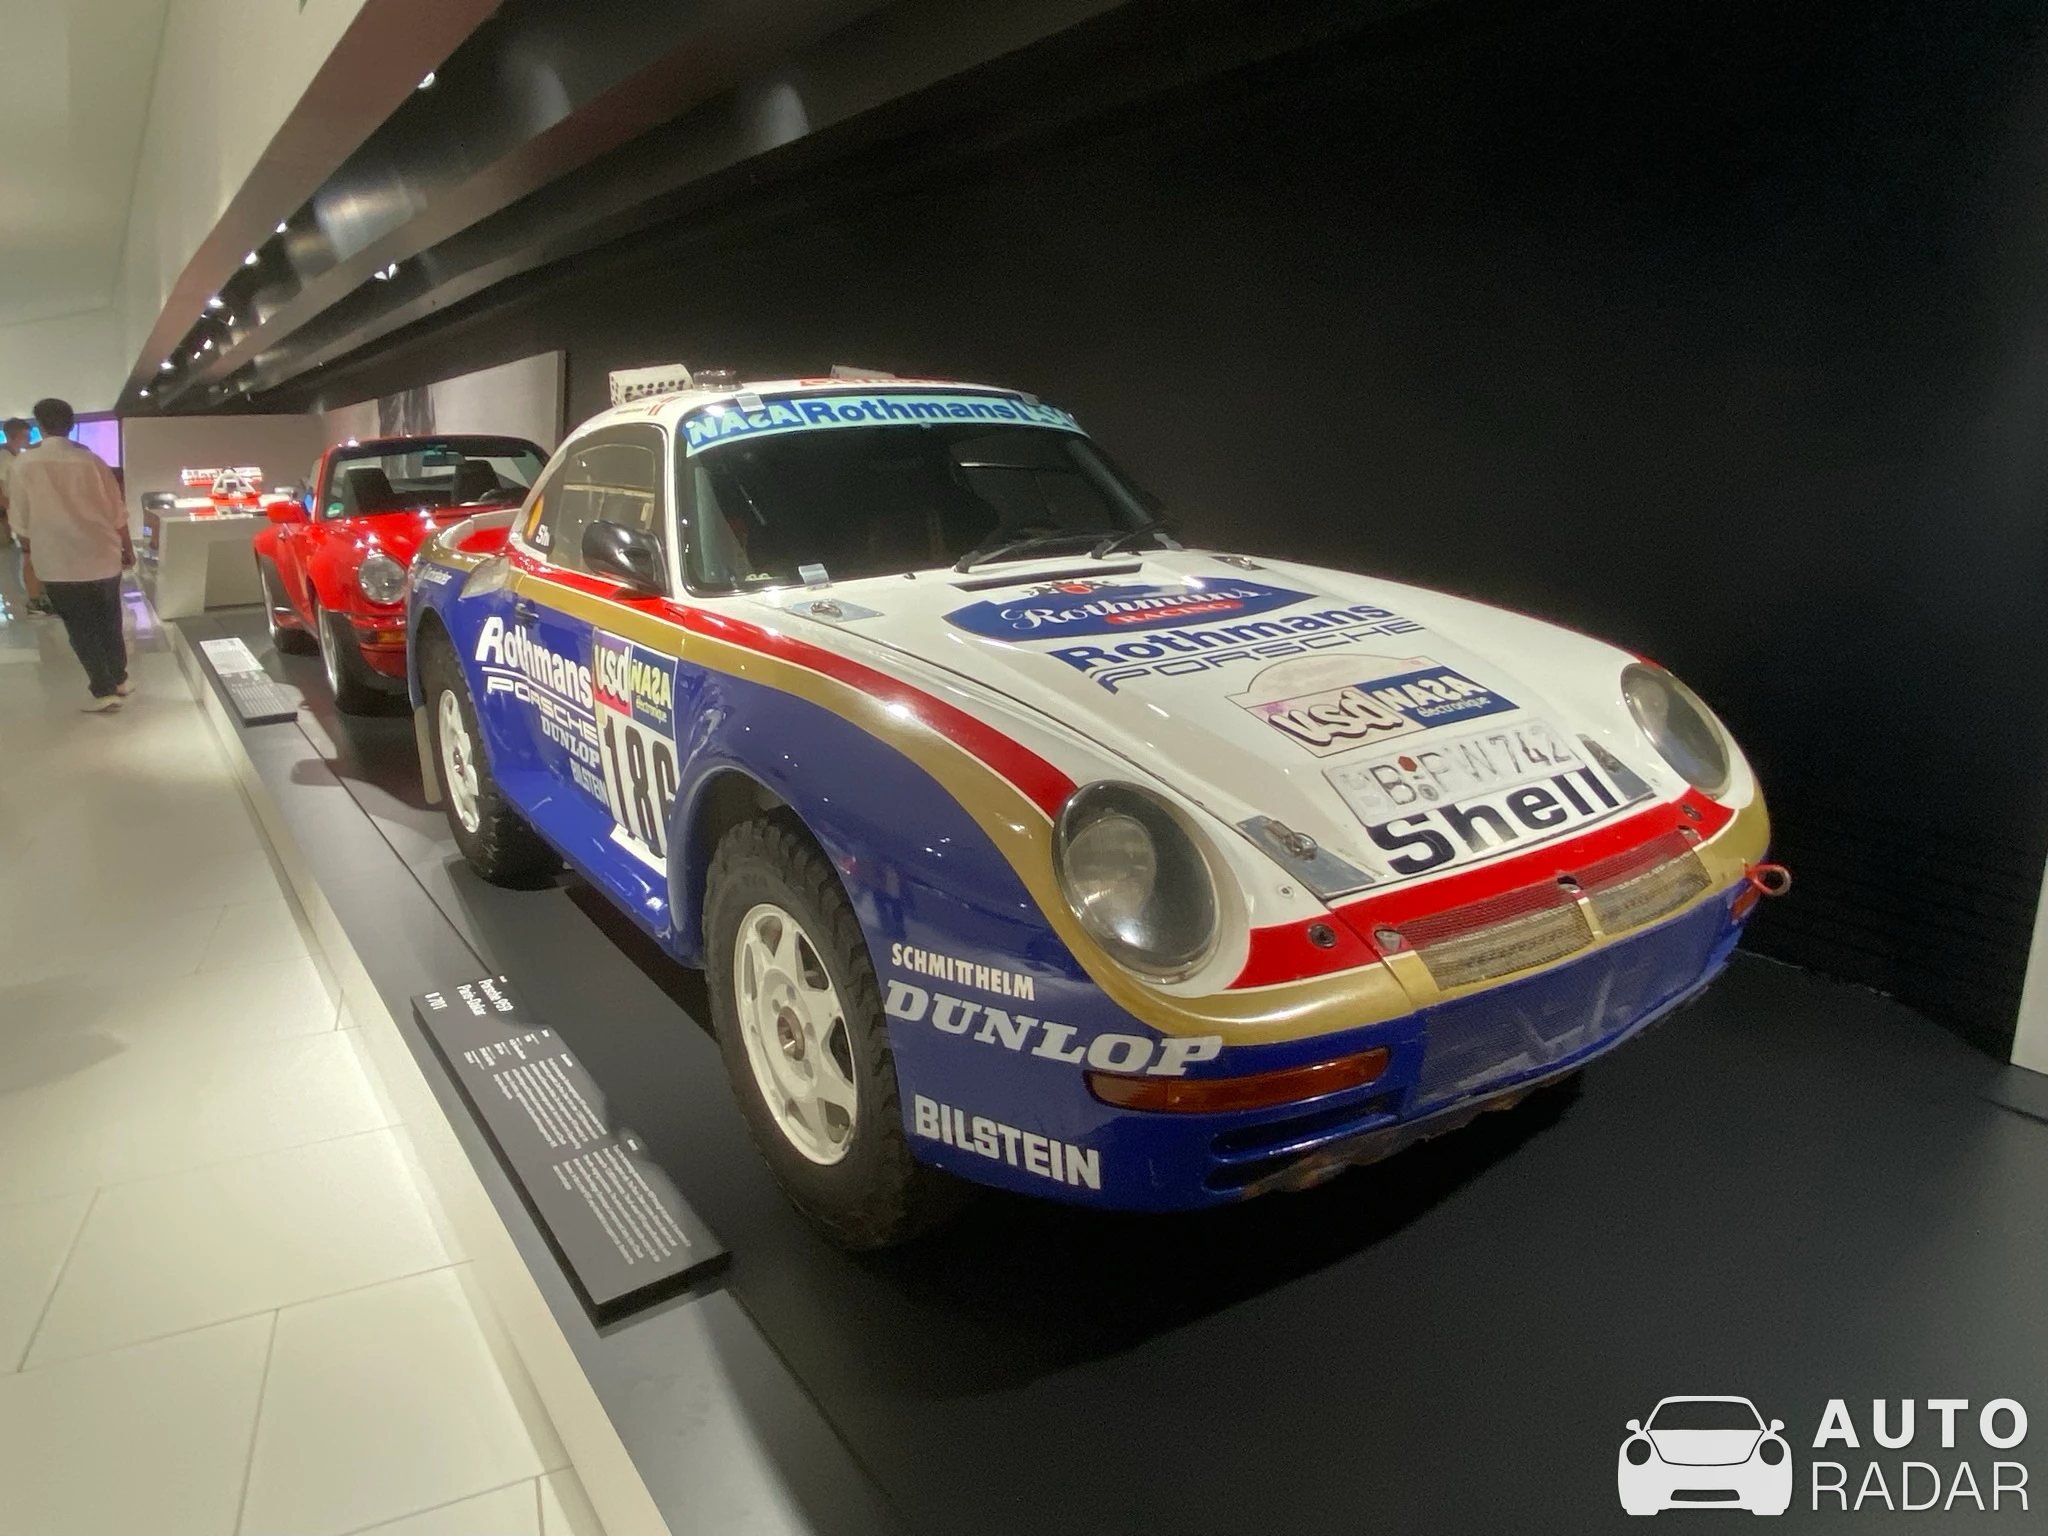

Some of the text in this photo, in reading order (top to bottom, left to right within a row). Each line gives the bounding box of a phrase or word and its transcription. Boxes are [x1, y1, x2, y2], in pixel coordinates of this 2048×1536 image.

[800, 398, 1017, 424] Rothmans
[1000, 587, 1272, 630] Rothmans
[1047, 605, 1400, 672] Rothmans
[1120, 603, 1232, 624] RACING
[475, 616, 593, 709] Rothmans
[1091, 619, 1427, 695] PORSCHE
[487, 676, 599, 746] PORSCHE
[541, 715, 600, 770] DUNLOP
[1367, 766, 1622, 875] Shell
[892, 942, 1035, 1001] SCHMITTHELM
[884, 979, 1223, 1076] DUNLOP
[914, 1094, 1101, 1190] BILSTEIN
